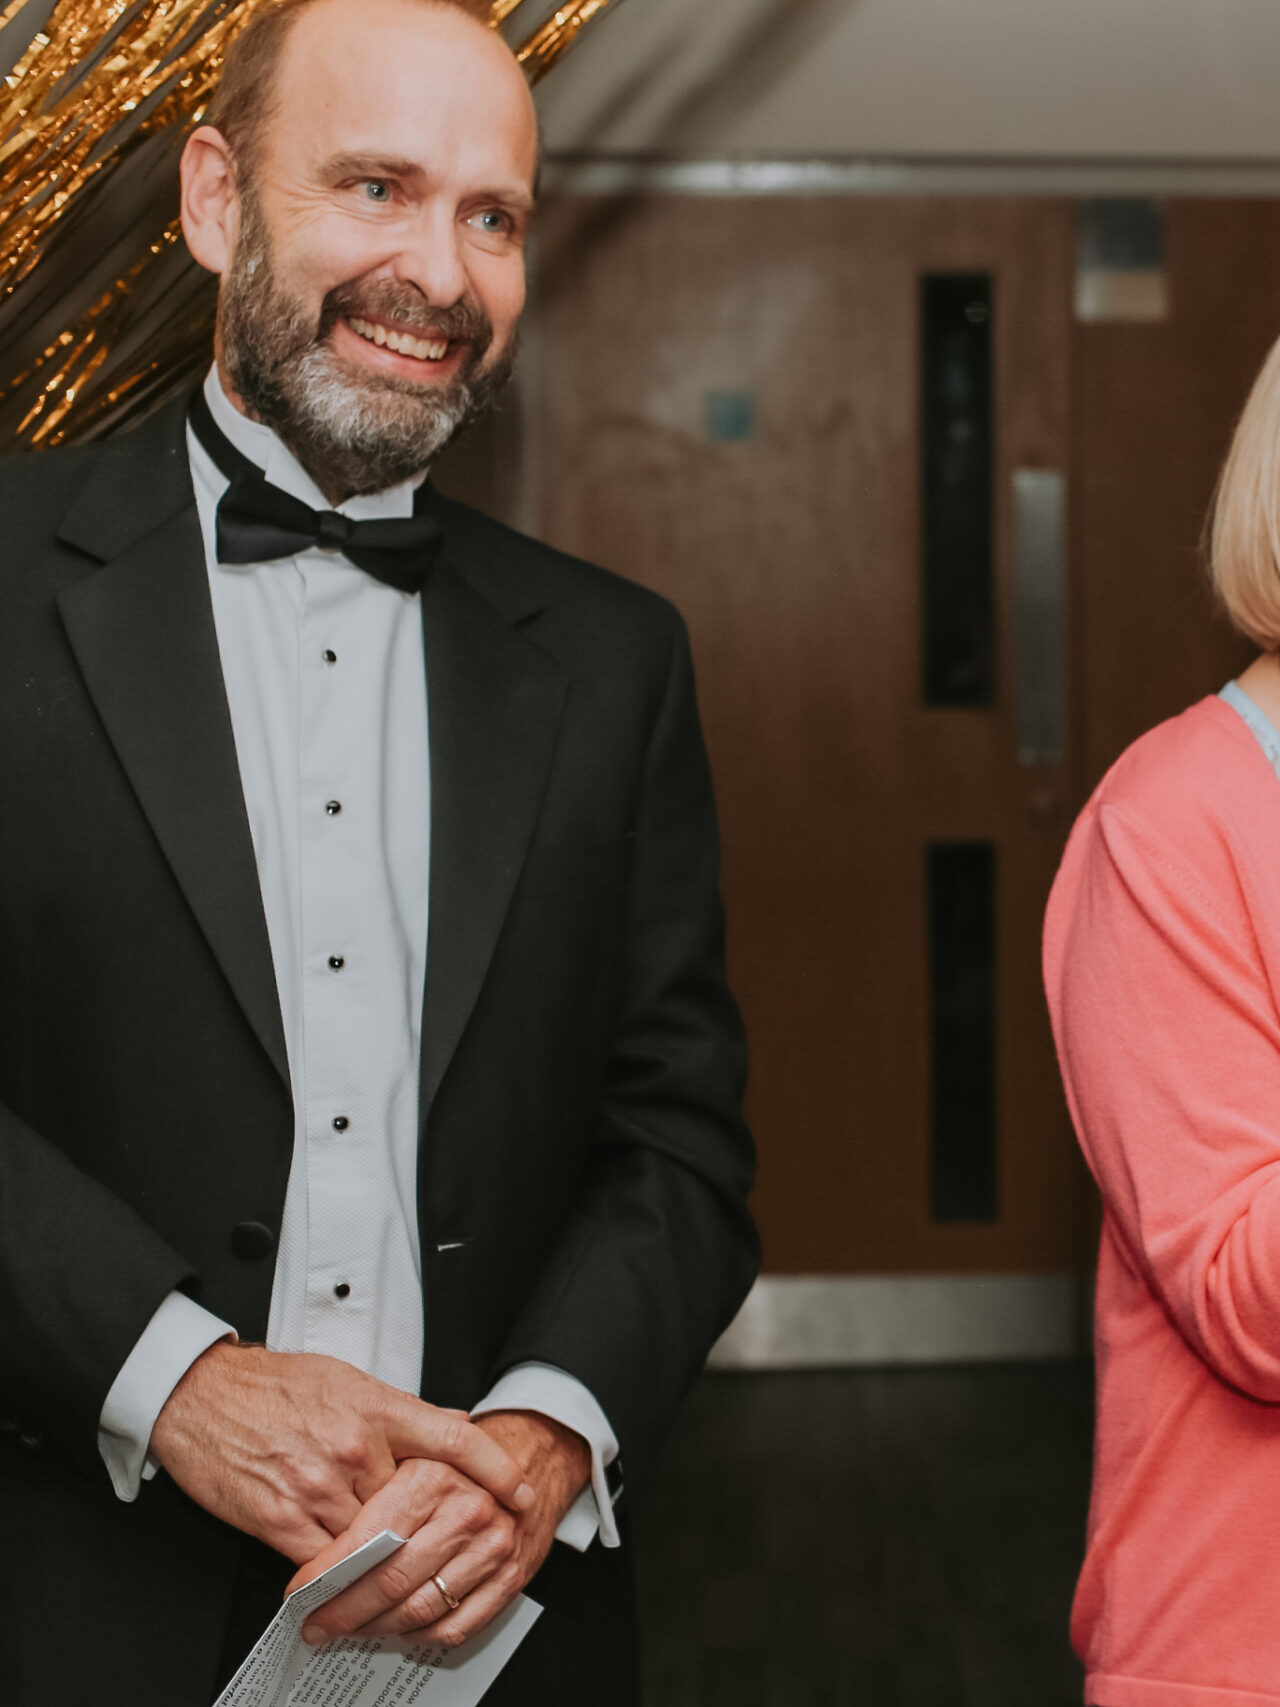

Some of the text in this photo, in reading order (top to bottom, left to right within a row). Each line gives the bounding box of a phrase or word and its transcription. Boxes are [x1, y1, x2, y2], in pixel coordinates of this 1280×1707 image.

[263, 1623, 279, 1646] been
[311, 1638, 337, 1673] indepe
[221, 1657, 257, 1706] wonderful
[300, 1679, 320, 1703] been
[320, 1638, 349, 1676] working
[312, 1687, 326, 1705] can
[325, 1655, 348, 1685] safely
[322, 1684, 340, 1707] need
[339, 1666, 350, 1682] for
[334, 1643, 382, 1707] ractice, going
[371, 1666, 405, 1707] mportant
[403, 1653, 413, 1664] to
[395, 1685, 406, 1698] all
[405, 1647, 433, 1685] aspects
[406, 1668, 434, 1705] worked
[431, 1657, 442, 1667] to
